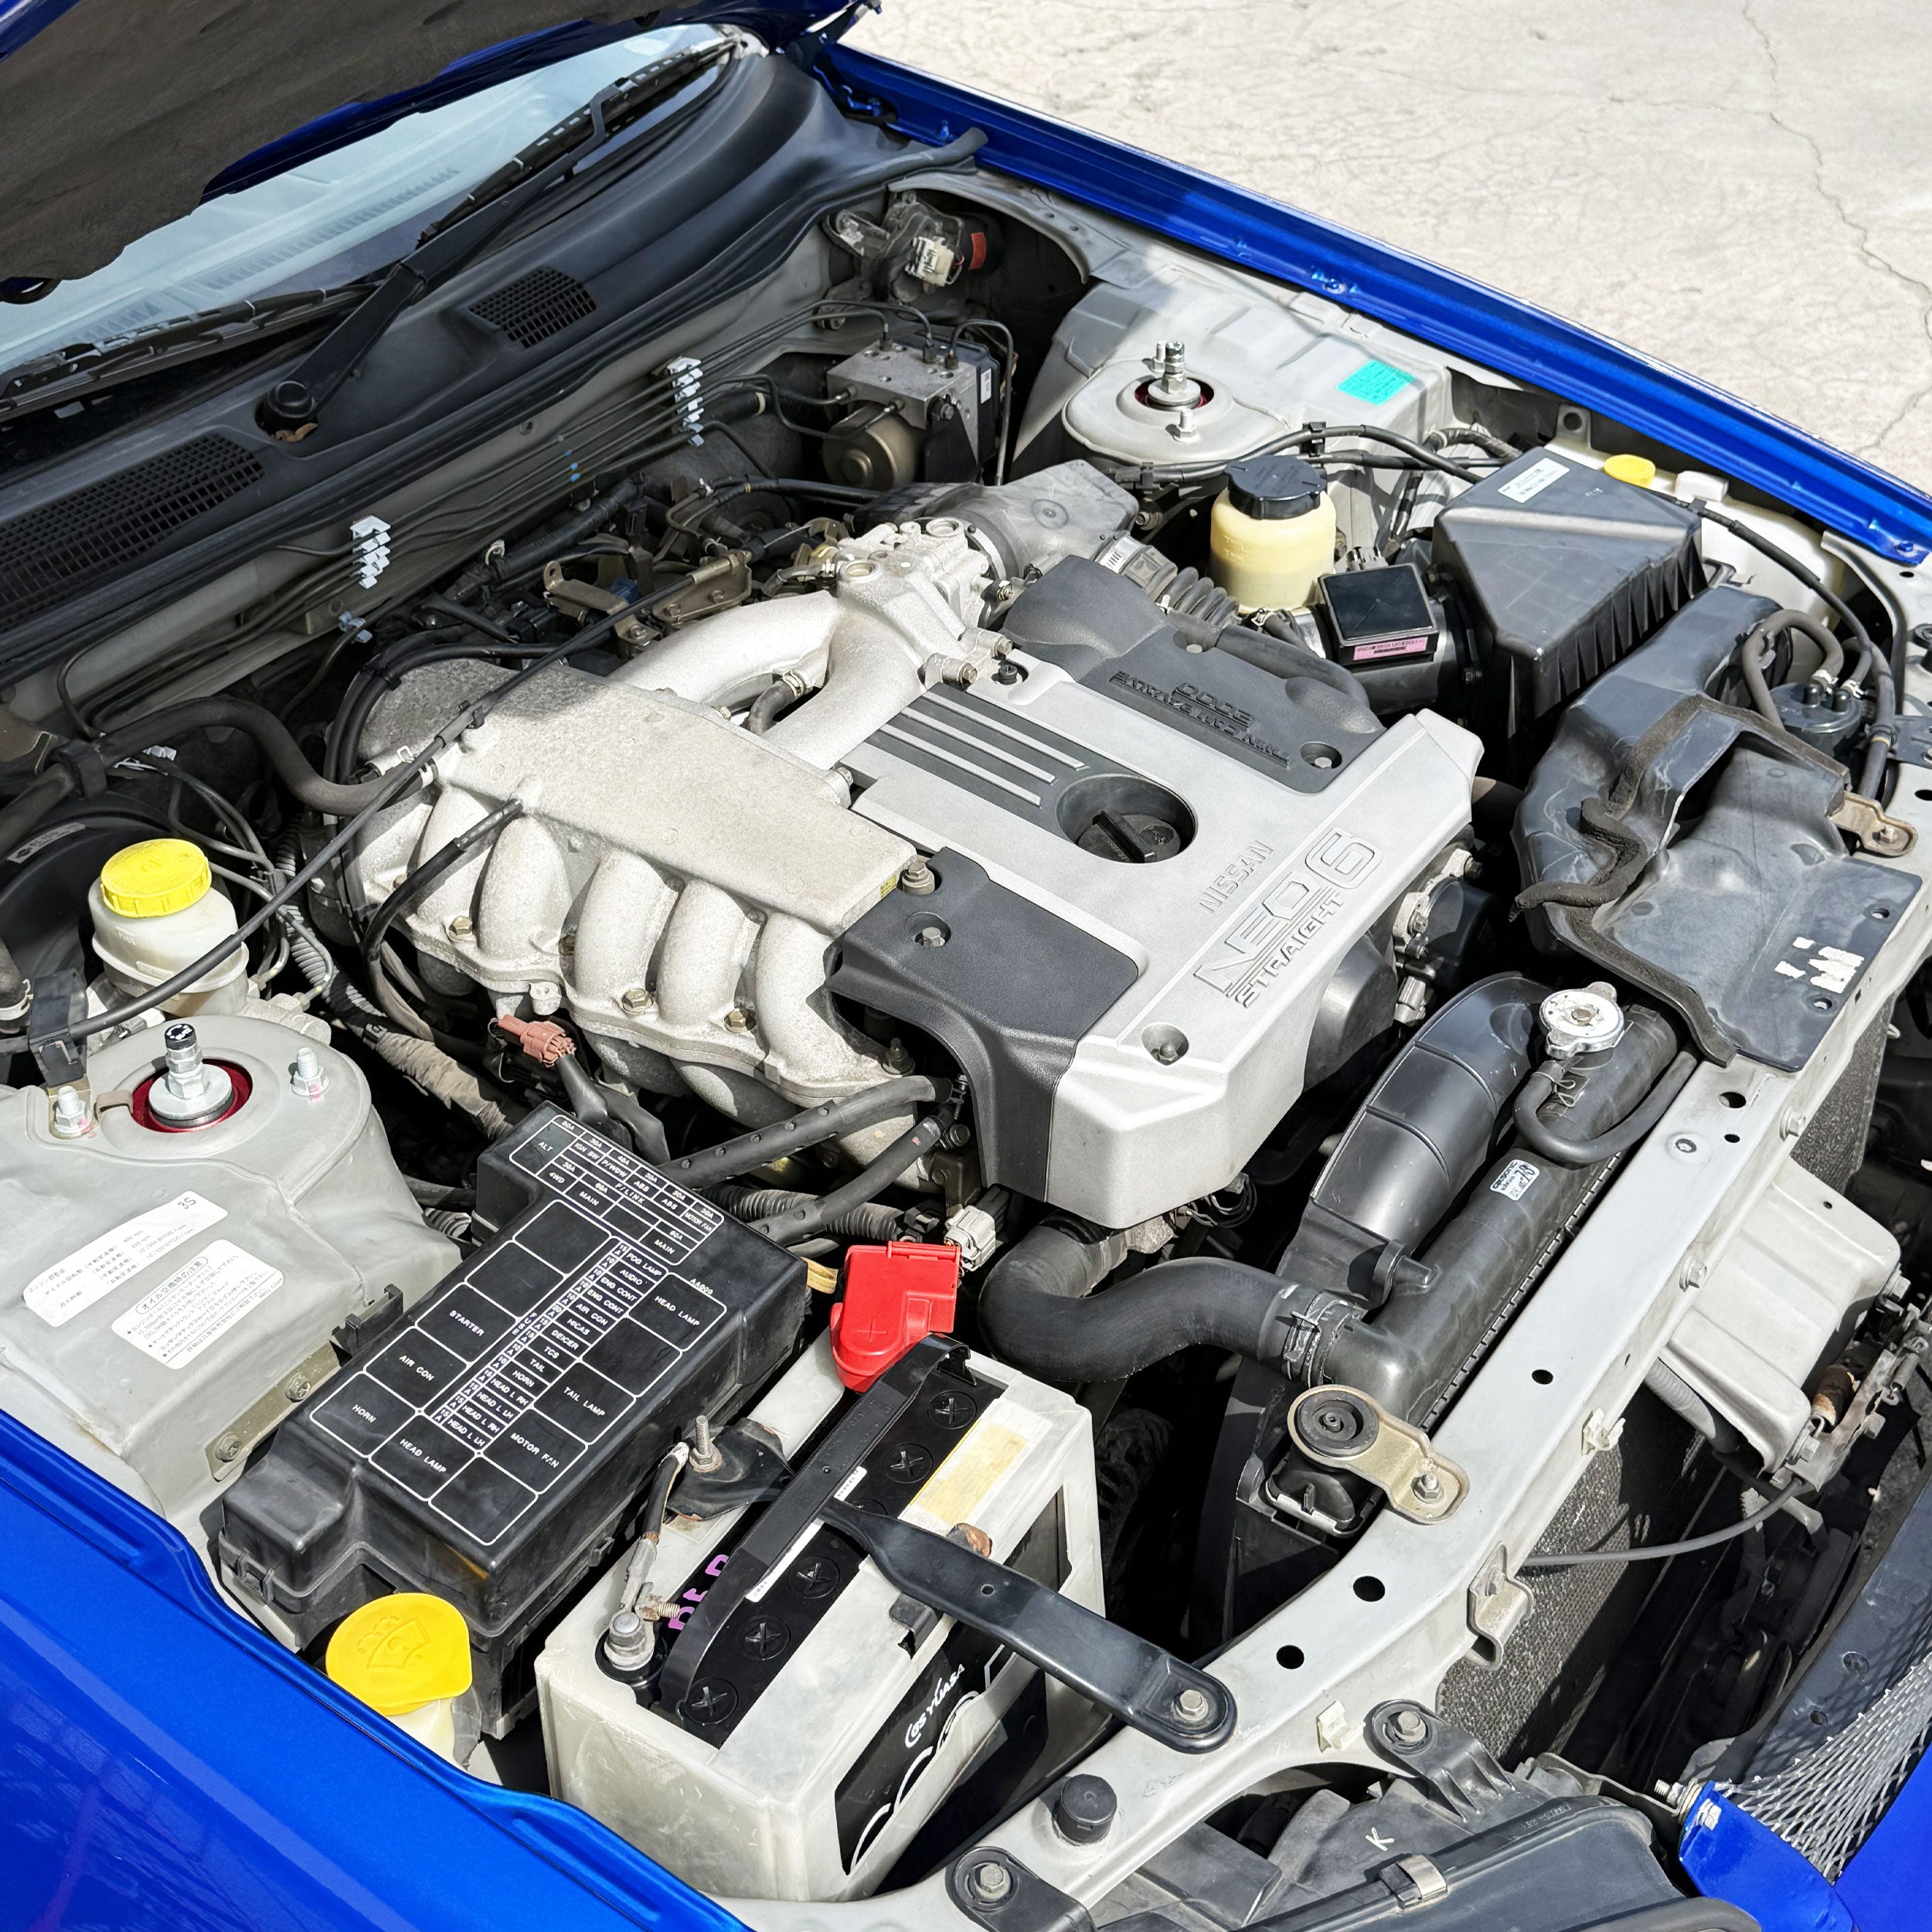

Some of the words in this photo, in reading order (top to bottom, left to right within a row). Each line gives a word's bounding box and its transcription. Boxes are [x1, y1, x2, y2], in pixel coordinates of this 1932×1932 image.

[1175, 682, 1253, 727] 2000
[1196, 840, 1274, 913] NISSAN
[1235, 889, 1343, 1009] STRAIGHT
[539, 1141, 553, 1152] ALT
[574, 1142, 587, 1153] IGN
[587, 1150, 600, 1160] SW
[590, 1138, 603, 1148] 30A
[563, 1162, 576, 1172] 30A
[601, 1160, 628, 1178] P/WDW
[549, 1172, 565, 1184] 4WD
[634, 1181, 650, 1192] ABS
[178, 1197, 196, 1209] 3S
[579, 1191, 599, 1206] MAIN
[615, 1183, 645, 1204] F/LINK
[662, 1198, 678, 1210] ABS
[685, 1212, 702, 1225] MOTOR
[702, 1223, 713, 1232] FAN
[701, 1208, 714, 1218] 30A
[654, 1240, 675, 1254] MAIN
[626, 1253, 642, 1265] FOG
[642, 1264, 662, 1277] LAMP
[620, 1270, 643, 1285] AUDIO
[600, 1277, 616, 1289] ENG
[617, 1287, 637, 1301] CONT
[587, 1289, 603, 1302] ENG
[604, 1300, 624, 1314] CONT
[655, 1295, 676, 1311] HEAD
[678, 1311, 700, 1326] LAMP
[449, 1310, 485, 1336] STARTER
[576, 1303, 590, 1314] AIR
[590, 1313, 608, 1326] CON
[567, 1318, 590, 1335] HICAS
[551, 1329, 580, 1350] DEICER
[544, 1346, 560, 1359] TCS
[400, 1355, 415, 1367] AIR
[416, 1366, 434, 1381] CON
[529, 1358, 544, 1372] TAIL
[512, 1370, 535, 1387] HORN
[491, 1379, 510, 1393] HEAD
[516, 1395, 529, 1406] RH
[563, 1386, 580, 1402] TAIL
[583, 1400, 605, 1416] LAMP
[352, 1404, 376, 1423] HORN
[477, 1392, 496, 1407] HEAD
[502, 1409, 514, 1420] LH
[462, 1405, 481, 1420] HEAD
[488, 1422, 500, 1433] RH
[447, 1419, 468, 1434] HEAD
[474, 1436, 485, 1447] LH
[400, 1438, 423, 1457] HEAD
[423, 1456, 447, 1472] LAMP
[511, 1432, 540, 1455] MOTOR
[541, 1453, 560, 1468] FAN
[927, 1663, 965, 1716] YUASA
